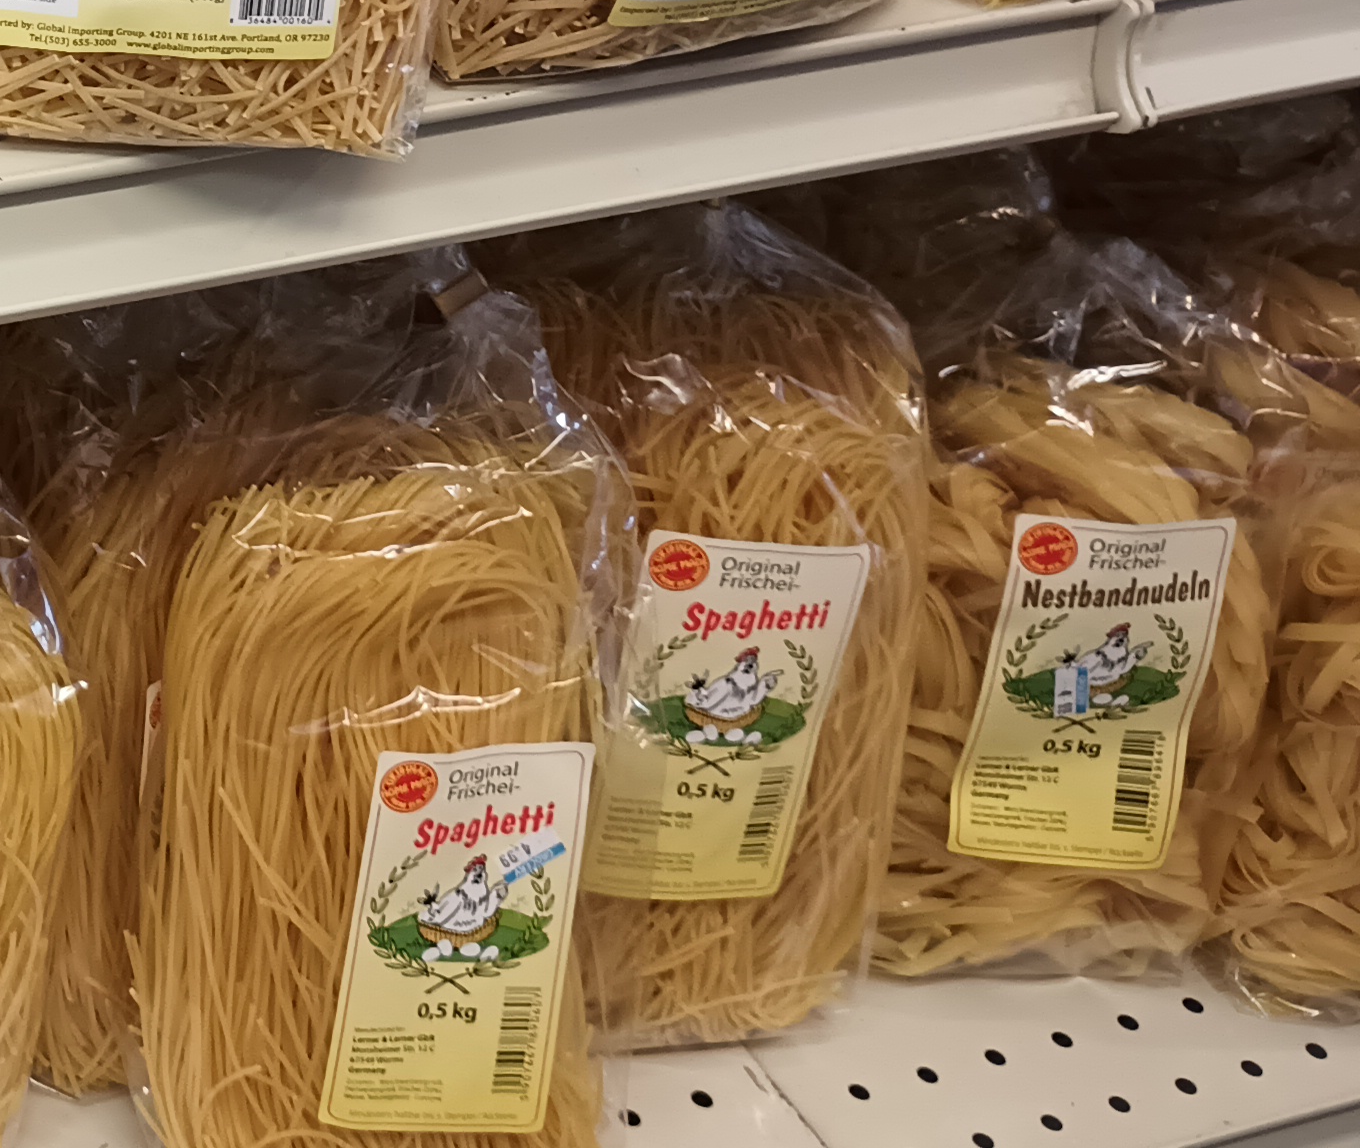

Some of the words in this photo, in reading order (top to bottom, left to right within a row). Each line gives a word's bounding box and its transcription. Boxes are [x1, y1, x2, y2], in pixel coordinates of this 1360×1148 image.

[21, 21, 35, 30] by:
[37, 22, 65, 34] Global
[68, 26, 114, 37] Importing
[149, 29, 174, 40] 4201
[175, 32, 189, 41] NE
[192, 33, 218, 41] 161st
[285, 34, 298, 42] OR
[72, 38, 117, 47] 655-3000
[1089, 537, 1166, 557] Original
[721, 556, 801, 576] Original
[1088, 554, 1167, 571] Frischei-
[718, 572, 802, 591] Frischei-
[1022, 570, 1211, 610] Nestbandnudeln
[682, 599, 830, 640] Spaghetti
[1042, 739, 1073, 754] 0,5
[1077, 739, 1102, 759] kg
[449, 761, 519, 784] Original
[447, 779, 521, 801] Frischei-
[711, 781, 735, 802] kg
[414, 802, 555, 855] Spaghetti
[417, 1003, 447, 1020] 0,5
[452, 1002, 477, 1024] kg
